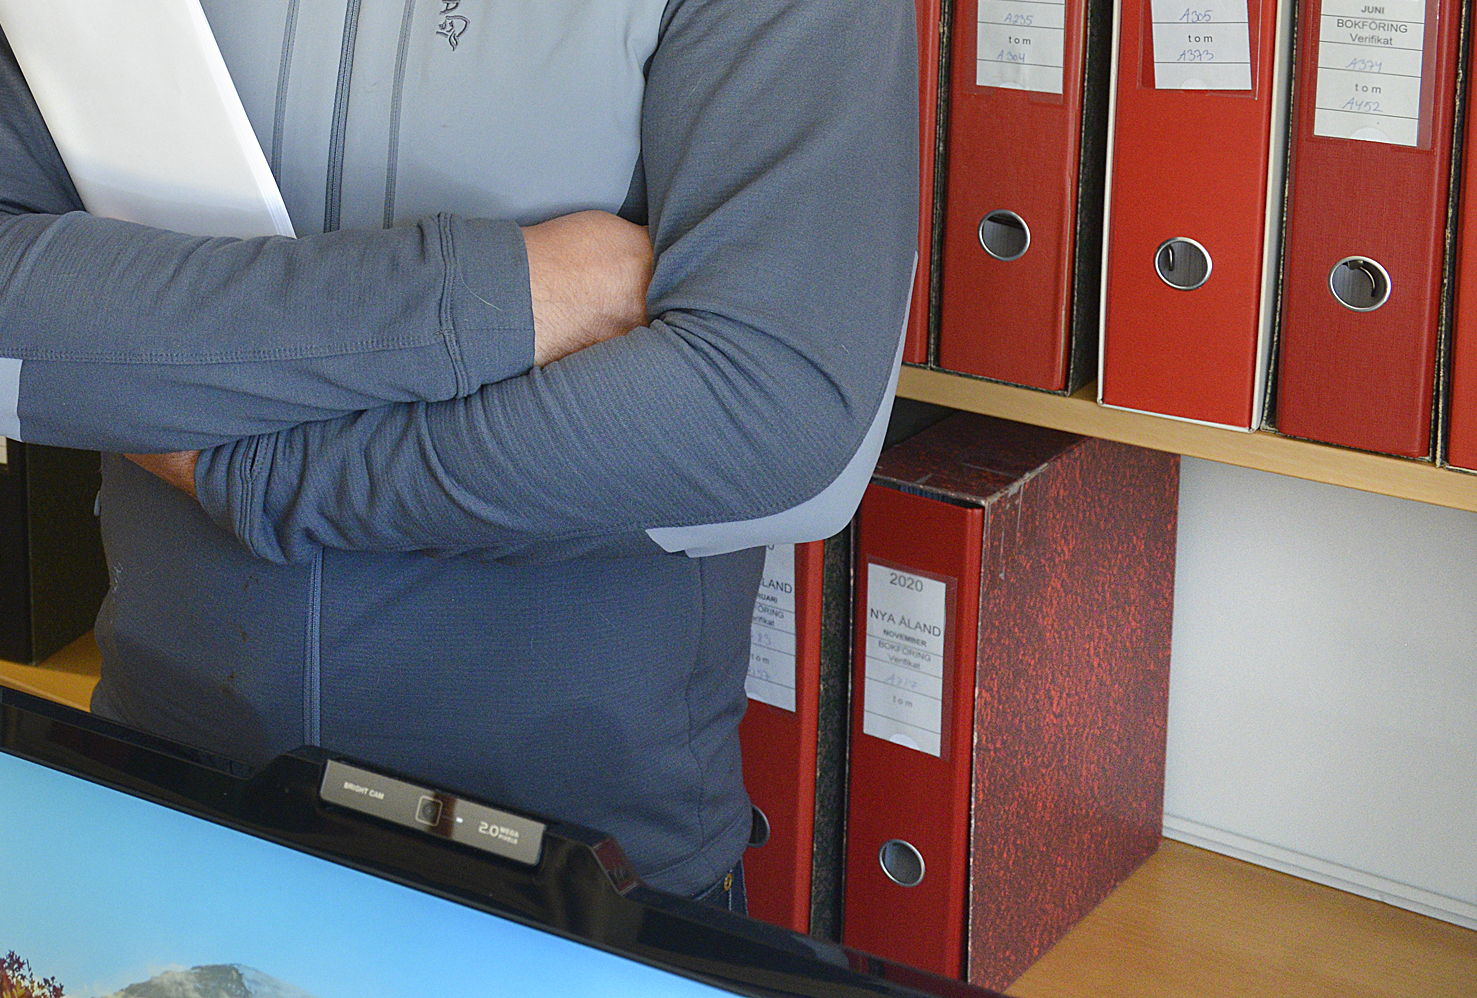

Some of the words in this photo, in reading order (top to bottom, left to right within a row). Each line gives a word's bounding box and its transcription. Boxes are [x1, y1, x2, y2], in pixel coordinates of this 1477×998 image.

[1361, 5, 1385, 14] JUNI
[1337, 19, 1408, 33] BOKFÖRING
[1350, 33, 1393, 45] Verifikat
[761, 578, 792, 593] LAND
[890, 572, 923, 592] 2020
[870, 608, 895, 624] NYA
[899, 615, 941, 637] ÅLAND
[884, 629, 926, 646] NOVEMBER
[878, 640, 931, 662] BOKFÖRING
[343, 781, 368, 795] BRIGHT
[369, 789, 384, 800] CAM
[478, 821, 499, 837] 2.0
